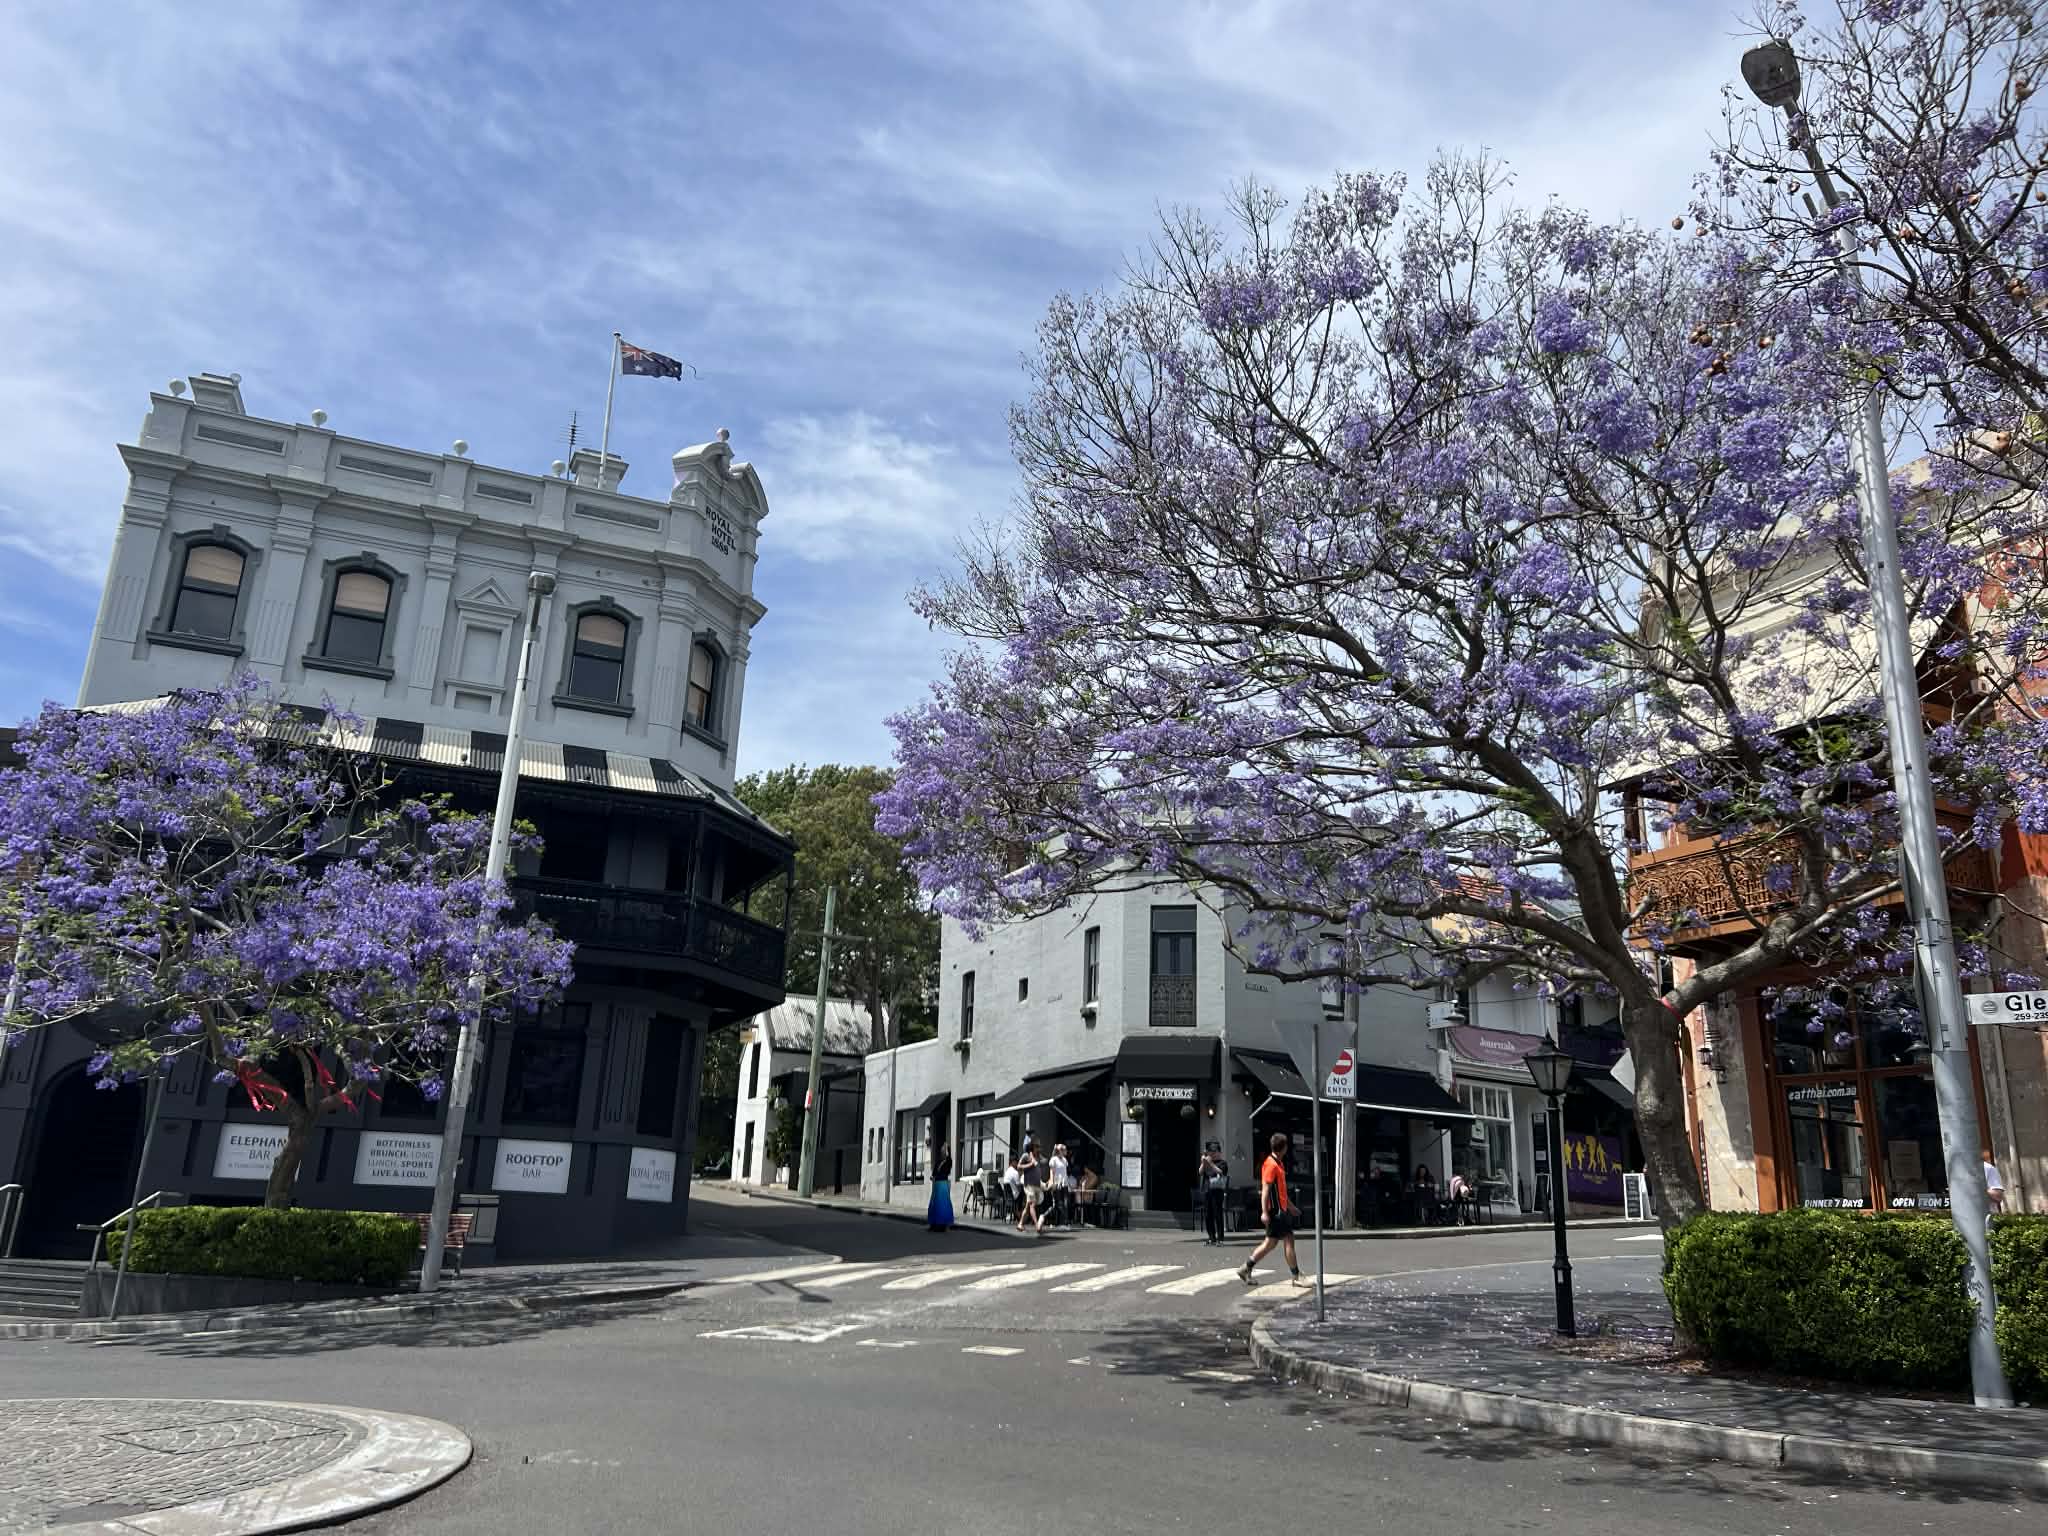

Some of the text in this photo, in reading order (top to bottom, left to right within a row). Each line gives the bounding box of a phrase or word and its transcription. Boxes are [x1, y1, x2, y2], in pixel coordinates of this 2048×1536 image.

[706, 506, 732, 535] ROYAL
[711, 522, 736, 550] HOTEL
[2005, 994, 2047, 1011] Gle
[1333, 1077, 1348, 1086] NO
[1327, 1086, 1352, 1095] ENTRY
[230, 1136, 288, 1148] ELEPHAN
[376, 1139, 431, 1149] BOTTOMLESS
[248, 1150, 271, 1161] BAR
[506, 1153, 564, 1166] ROOFTOP
[400, 1160, 433, 1169] SPORTS
[372, 1169, 391, 1177] LIVE
[522, 1167, 542, 1178] BAR
[1804, 1198, 1864, 1209] DINNER 7 DAYS
[1892, 1197, 1915, 1207] OPEN
